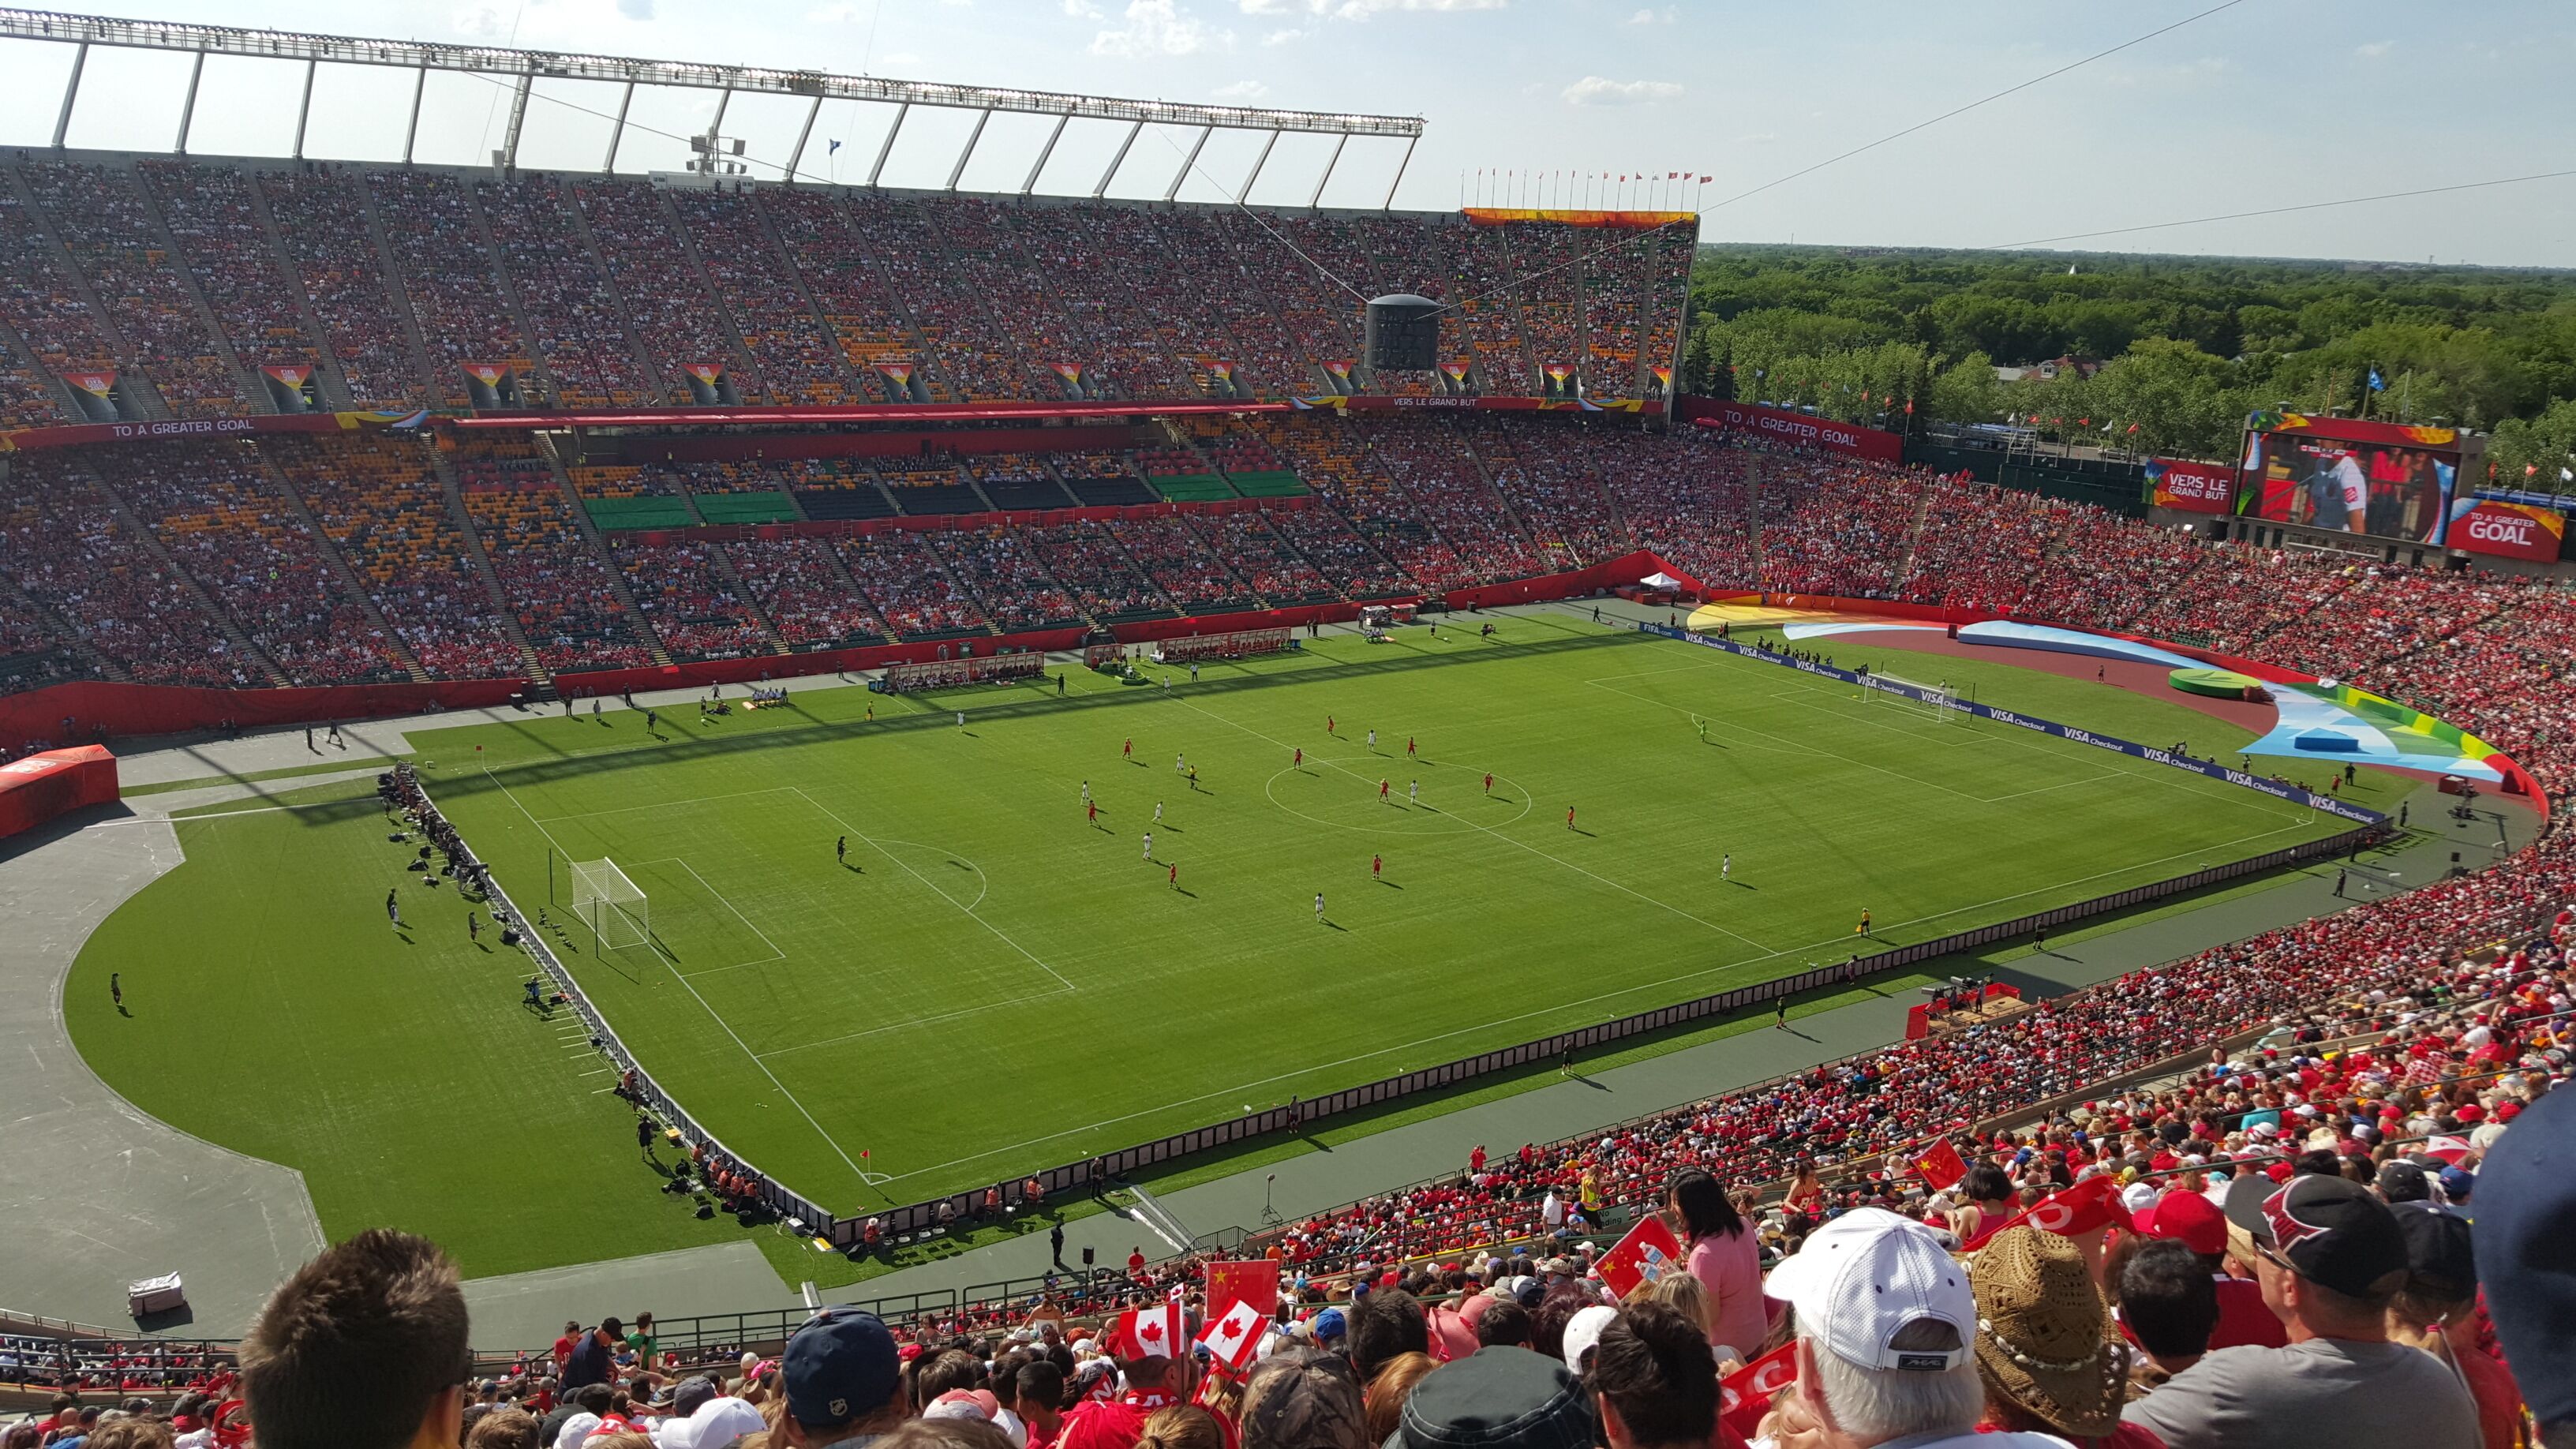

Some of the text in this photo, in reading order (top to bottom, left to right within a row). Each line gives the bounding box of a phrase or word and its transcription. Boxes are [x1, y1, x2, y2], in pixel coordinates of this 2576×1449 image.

[113, 419, 254, 436] TO A GREATER GOAL
[1725, 410, 1858, 447] TO A GREATER GOAL
[2169, 485, 2227, 500] GRAND BUT
[2170, 474, 2229, 492] VERS LE
[2495, 515, 2536, 527] GREATER
[2469, 521, 2532, 546] GOAL
[1685, 632, 1726, 650] VISA Checkout
[1738, 646, 1782, 665] VISA Checkout
[1795, 659, 1841, 680] VISA Checkout
[1855, 674, 1905, 696] VISA Checkout
[1919, 690, 1972, 713] VISA Checkout
[1989, 708, 2046, 732] VISA Checkout
[2064, 727, 2123, 751] VISA Checkout
[2141, 747, 2205, 774] VISA Checkout
[2223, 769, 2288, 798] VISA Checkout
[2307, 793, 2375, 823] VISA Checkout
